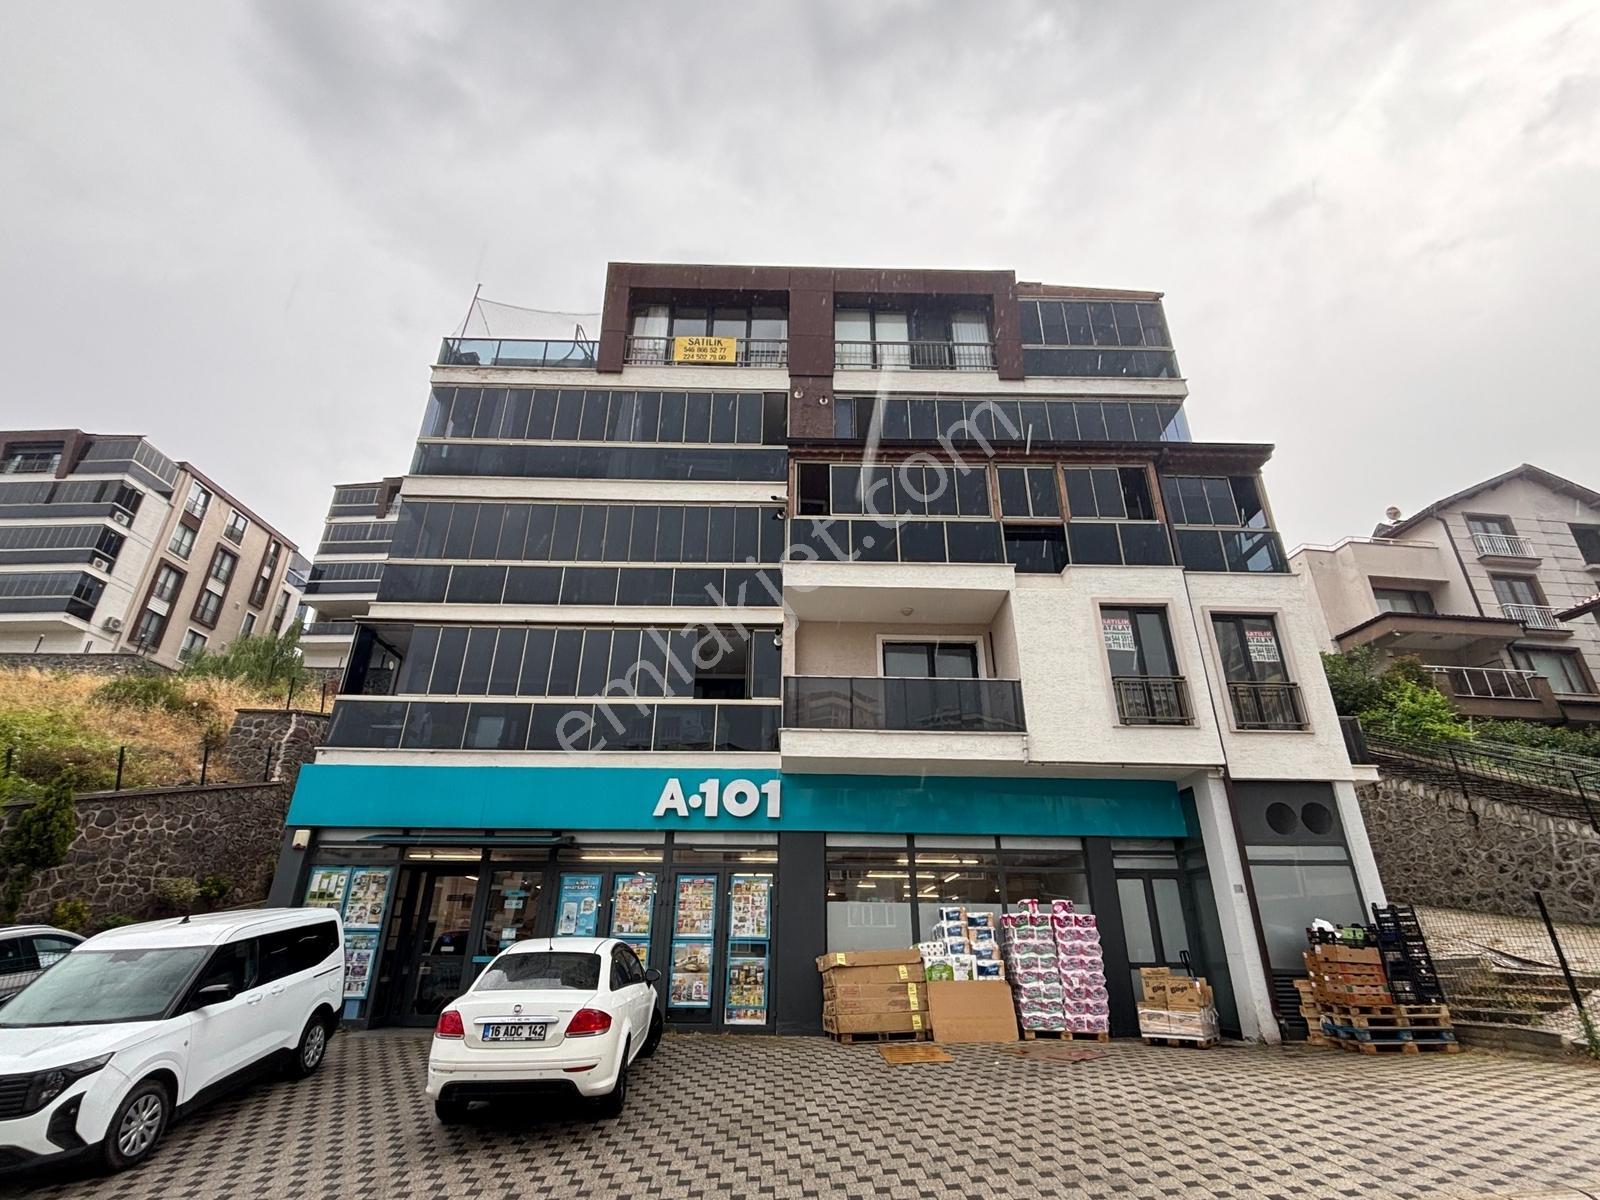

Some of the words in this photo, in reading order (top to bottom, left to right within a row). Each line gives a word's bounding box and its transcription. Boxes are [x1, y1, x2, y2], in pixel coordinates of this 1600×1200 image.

[688, 337, 723, 347] SATILIK
[490, 1025, 501, 1037] 16
[503, 1025, 523, 1037] ADC
[528, 1025, 545, 1037] 142
